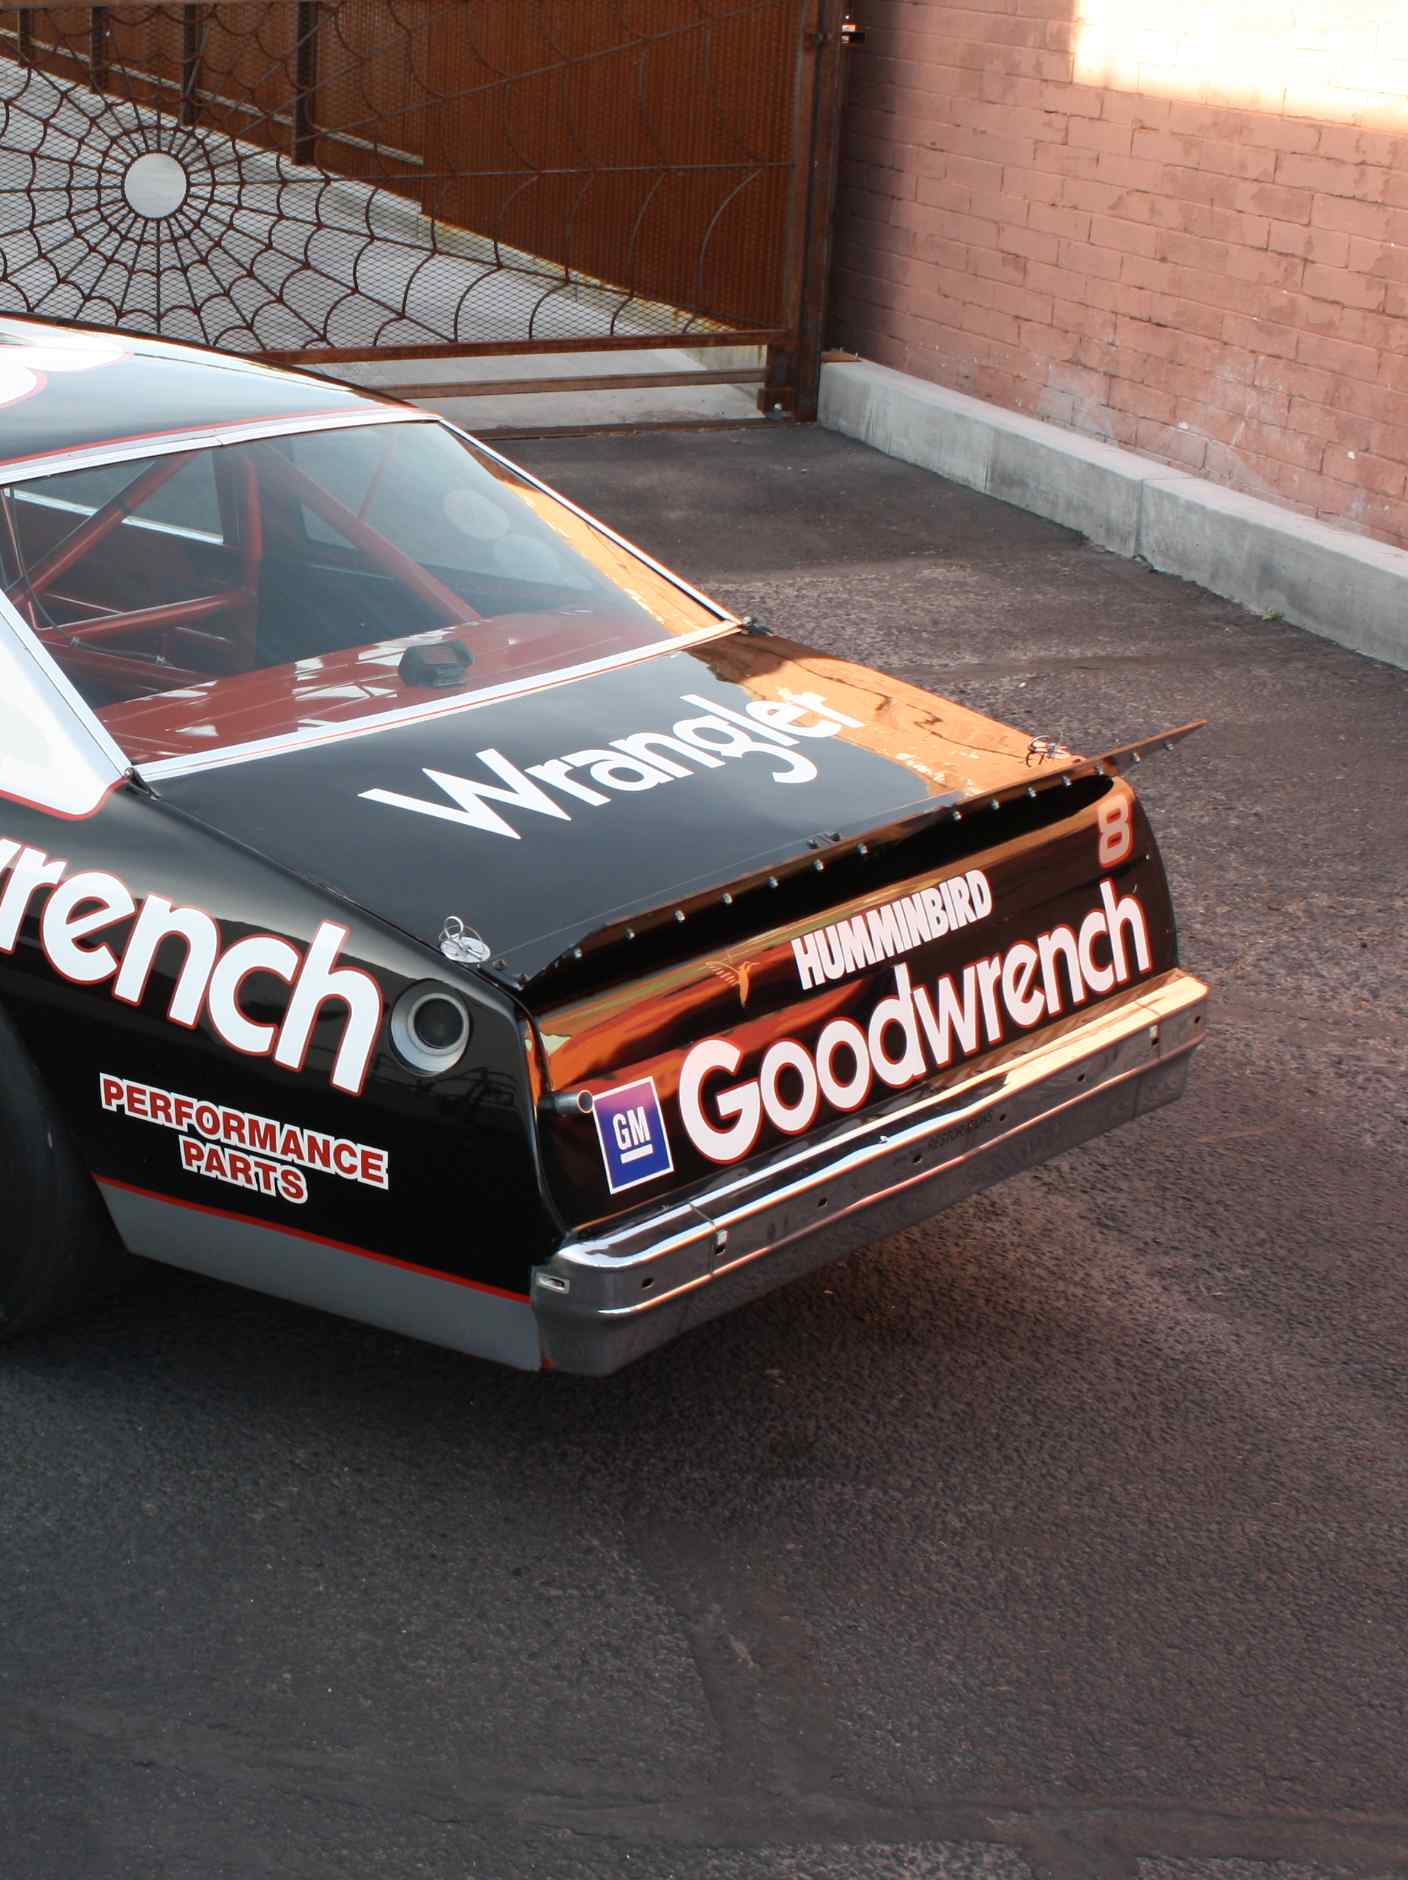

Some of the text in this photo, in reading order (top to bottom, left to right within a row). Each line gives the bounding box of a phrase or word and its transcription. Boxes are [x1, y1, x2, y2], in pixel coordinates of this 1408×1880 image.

[358, 687, 865, 840] Wrangler
[1097, 795, 1133, 868] 8
[792, 870, 993, 990] HUMMINBIRD
[678, 880, 1150, 1164] Goodwrench
[99, 1072, 389, 1190] PERFORMANCE
[179, 1135, 308, 1204] PARTS
[613, 1106, 651, 1150] GM
